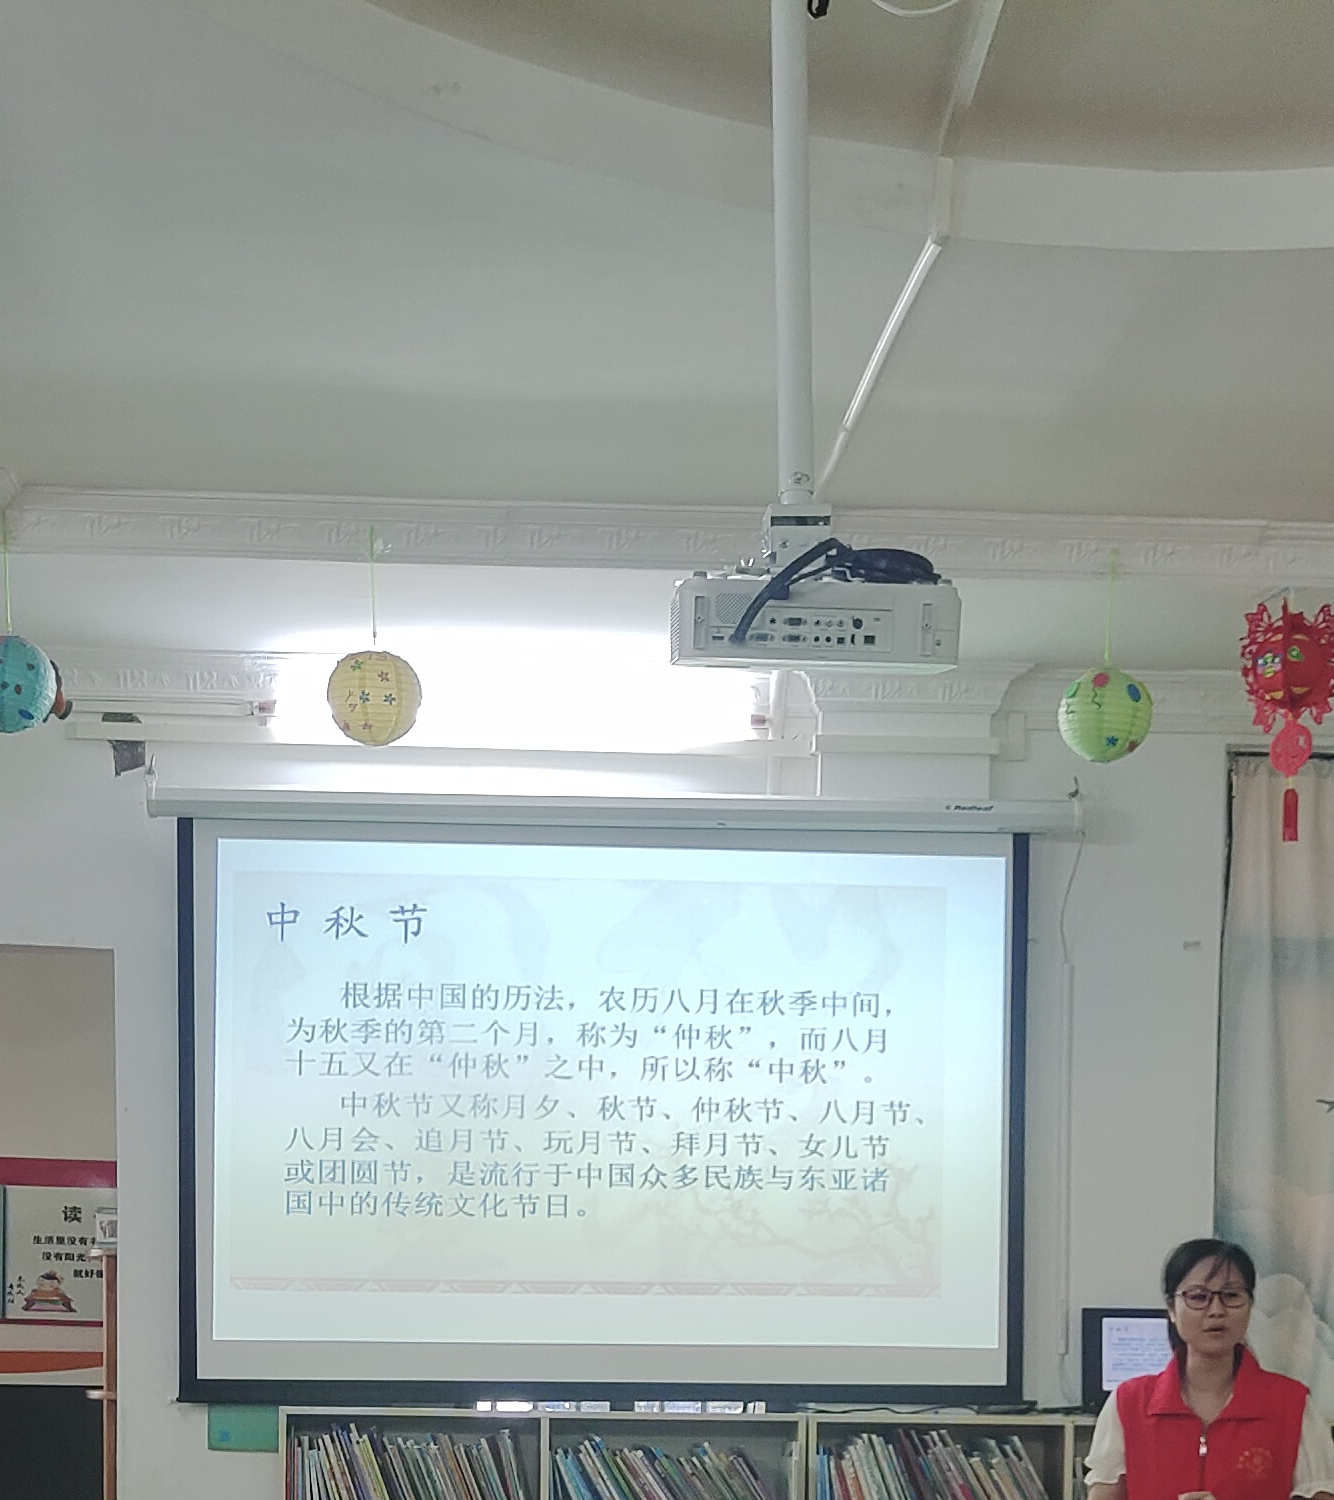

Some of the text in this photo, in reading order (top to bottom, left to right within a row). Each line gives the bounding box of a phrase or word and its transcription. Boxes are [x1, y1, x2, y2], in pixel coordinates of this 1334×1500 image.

[266, 902, 428, 945] 中秋节
[284, 1125, 890, 1159] 八月会、追月节、玩月节、拜月节、女儿节
[284, 1158, 889, 1193] 或团圆节，是流行于中国众多民族与东亚诸
[62, 1205, 83, 1224] 读
[284, 1188, 589, 1219] 国中的传统文化节日。
